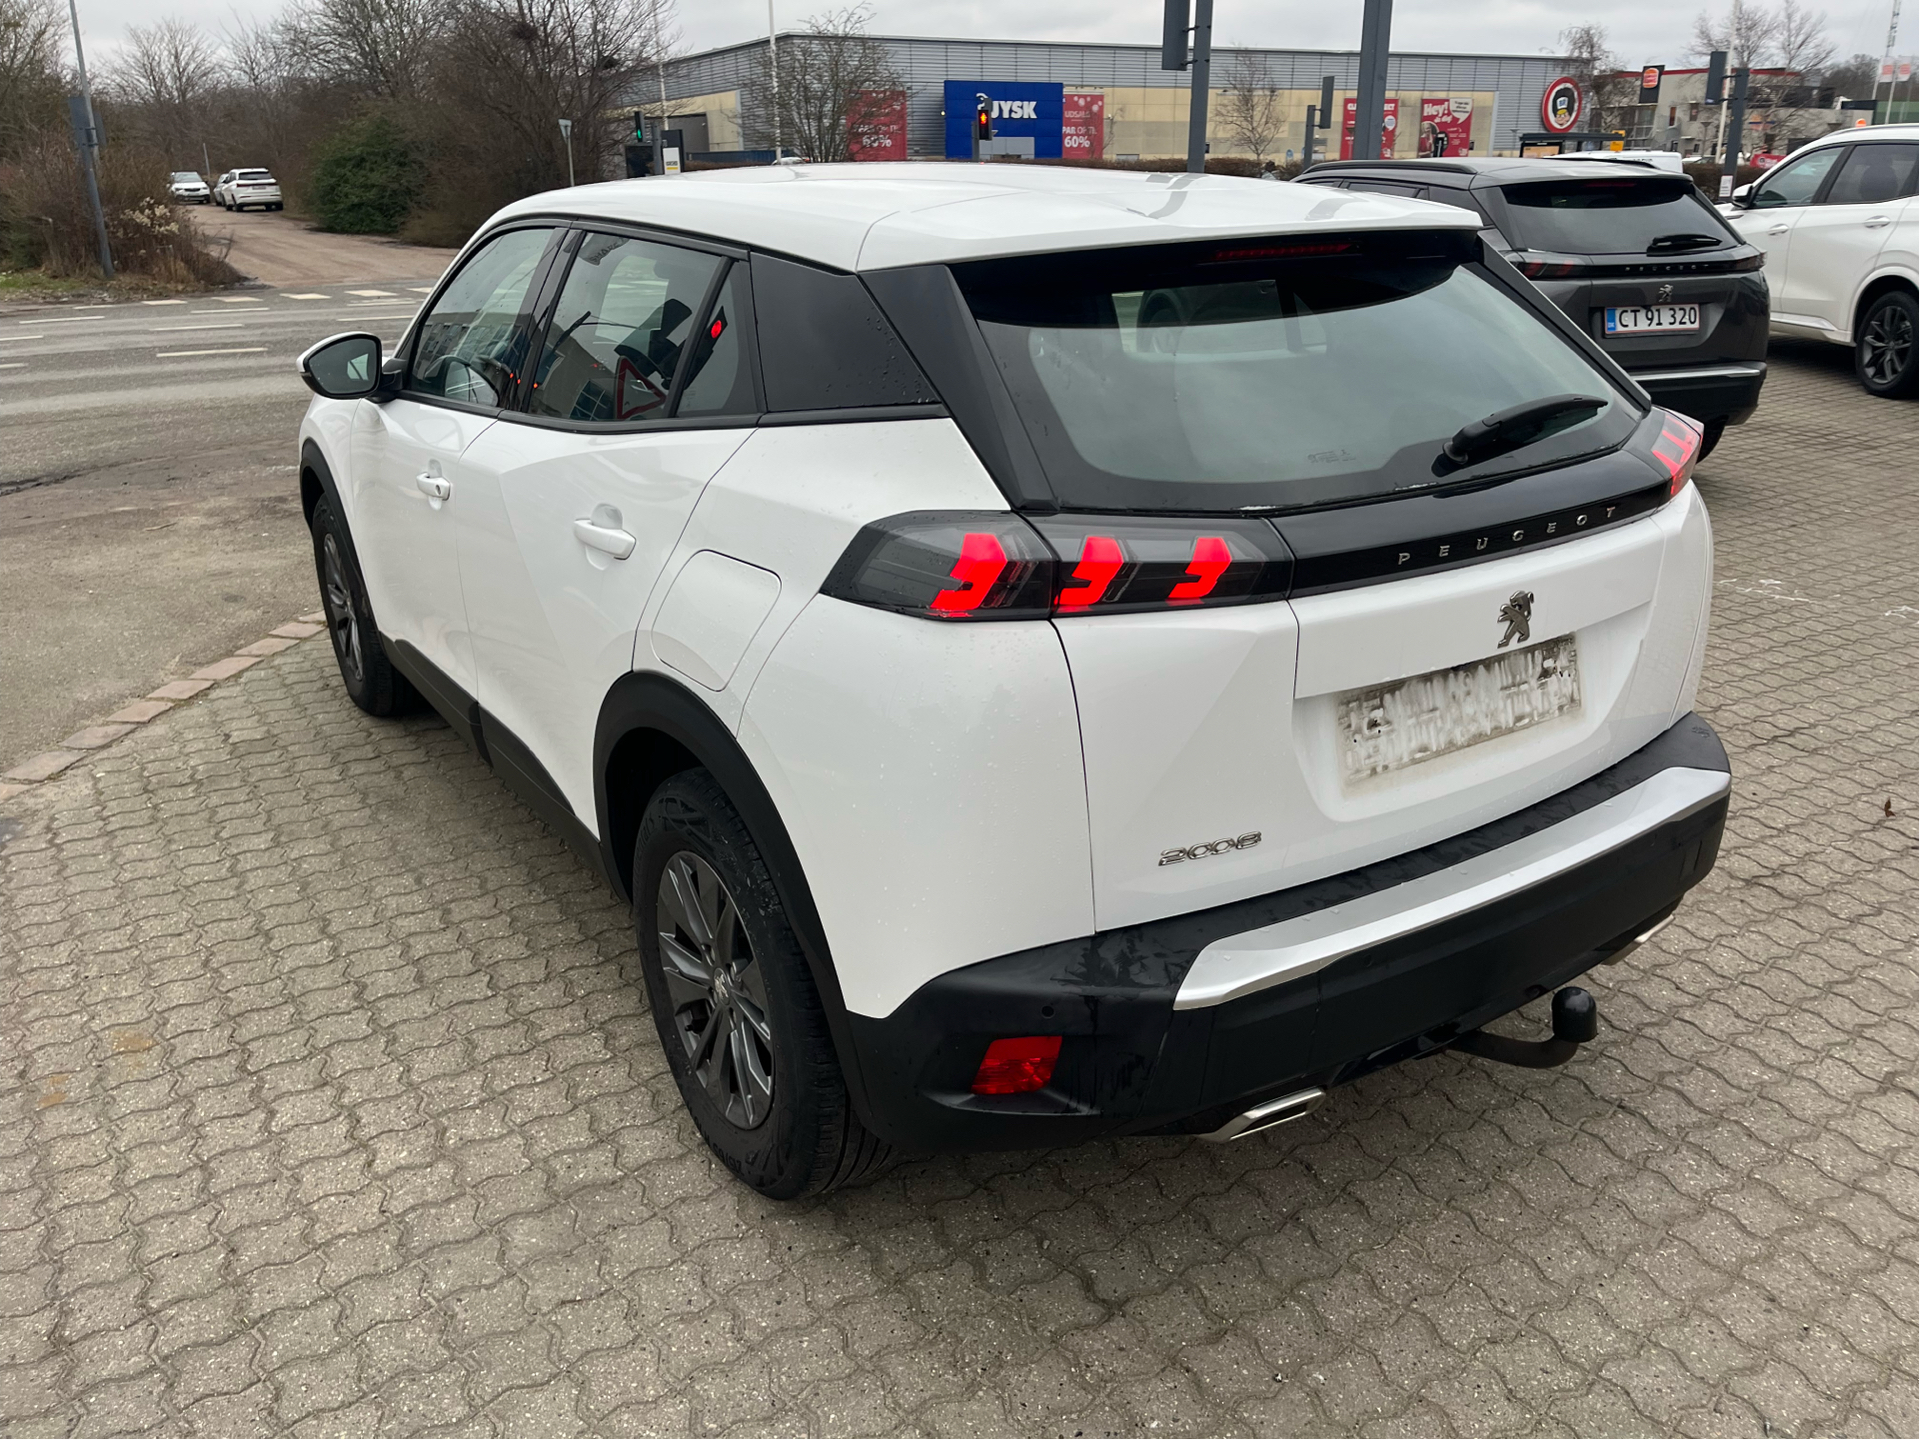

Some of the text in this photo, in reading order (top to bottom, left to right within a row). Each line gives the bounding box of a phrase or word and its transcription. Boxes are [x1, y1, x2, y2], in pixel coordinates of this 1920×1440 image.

[991, 101, 1038, 118] JYSK
[1064, 135, 1091, 148] 60%
[1618, 306, 1697, 328] CT 91 320
[1397, 506, 1616, 566] PEUGEOT
[1158, 831, 1262, 867] 2008
